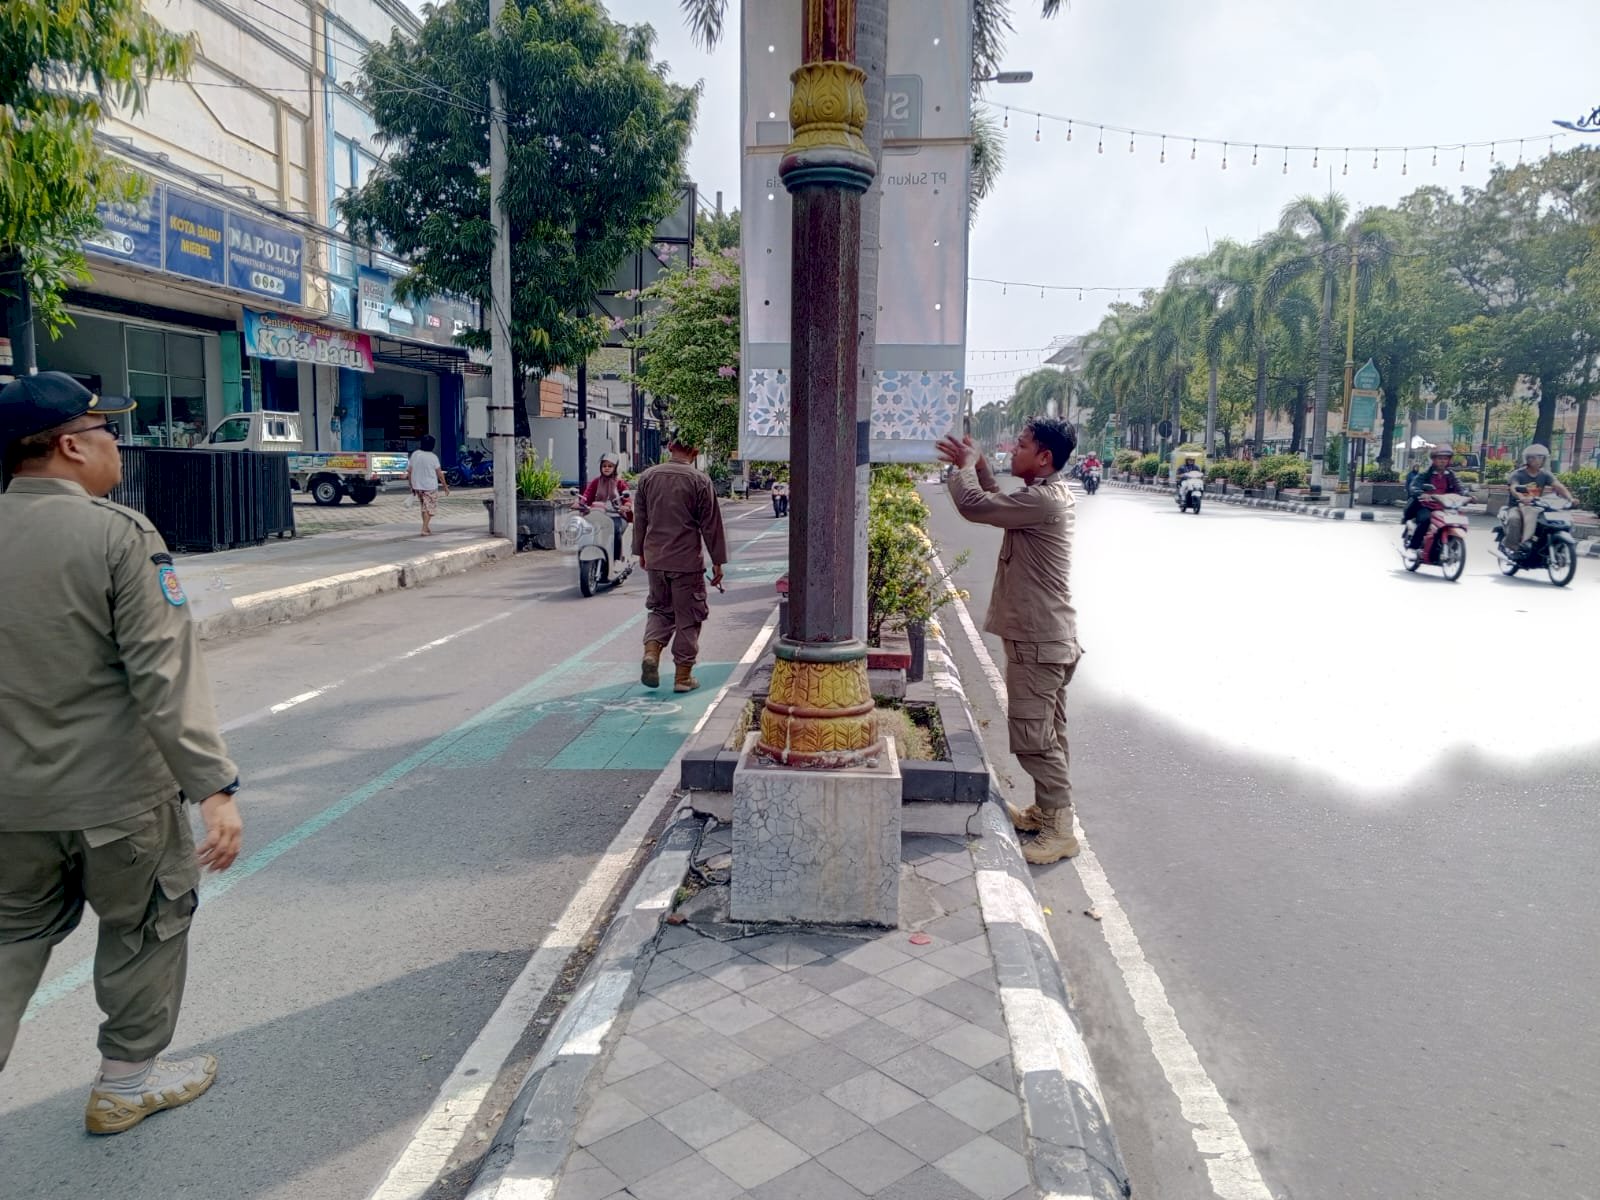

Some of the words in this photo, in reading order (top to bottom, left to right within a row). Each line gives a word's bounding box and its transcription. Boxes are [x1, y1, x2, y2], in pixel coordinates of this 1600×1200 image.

[169, 215, 196, 235] KOTA
[197, 223, 221, 244] BARU
[181, 239, 212, 260] MEBEL
[228, 226, 301, 266] NAPOLLY
[260, 315, 292, 330] Central
[258, 328, 310, 361] Kota
[314, 338, 365, 369] Baru
